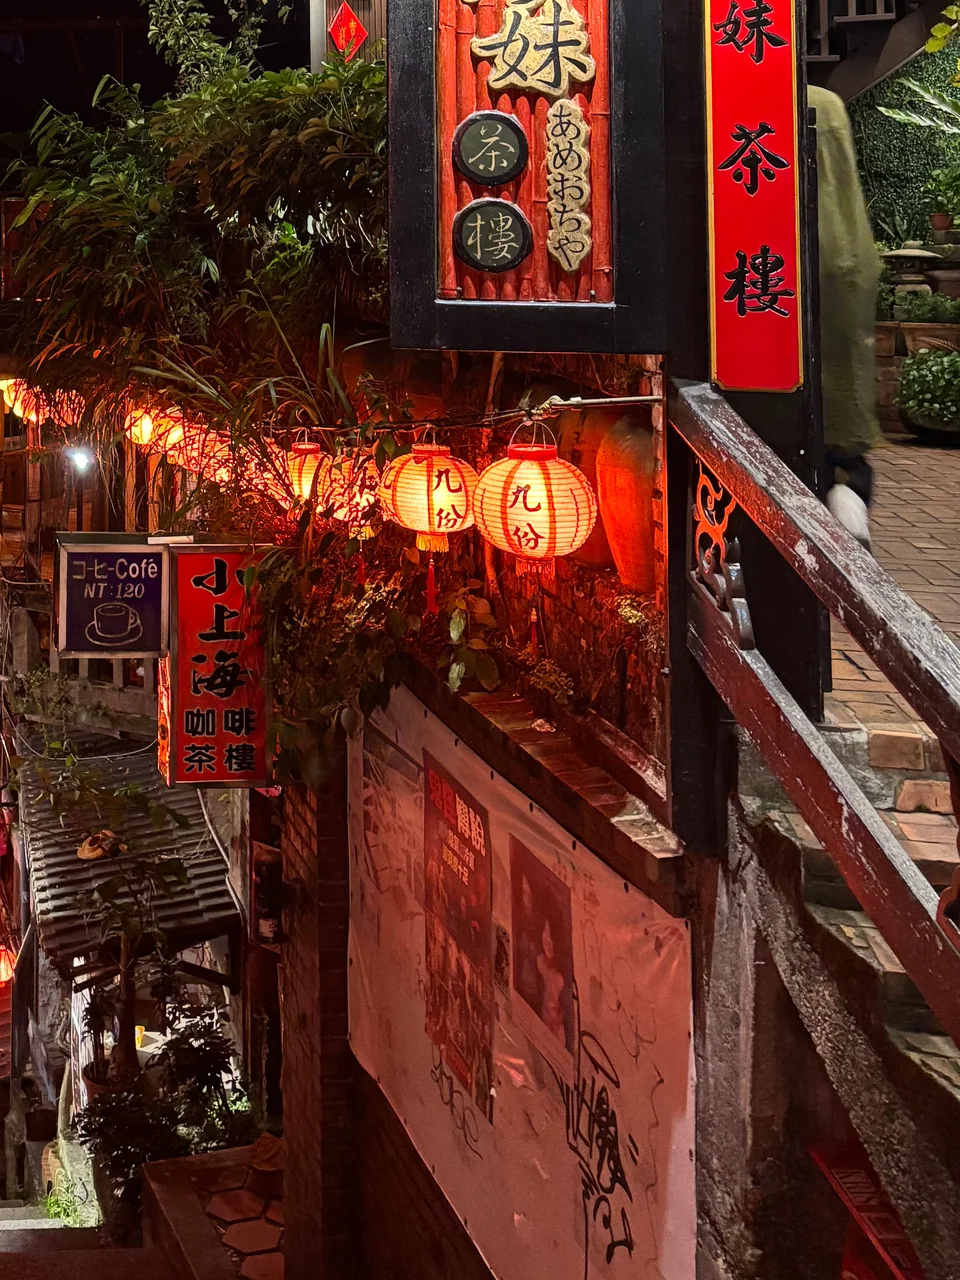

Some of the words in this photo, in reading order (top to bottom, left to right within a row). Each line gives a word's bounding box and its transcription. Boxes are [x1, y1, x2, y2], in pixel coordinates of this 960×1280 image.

[465, 125, 517, 261] 茶樓
[433, 467, 465, 530] 九份
[508, 483, 546, 552] 九份
[191, 557, 255, 700] 小上海
[183, 707, 257, 738] 咖啡
[183, 743, 257, 774] 茶樓
